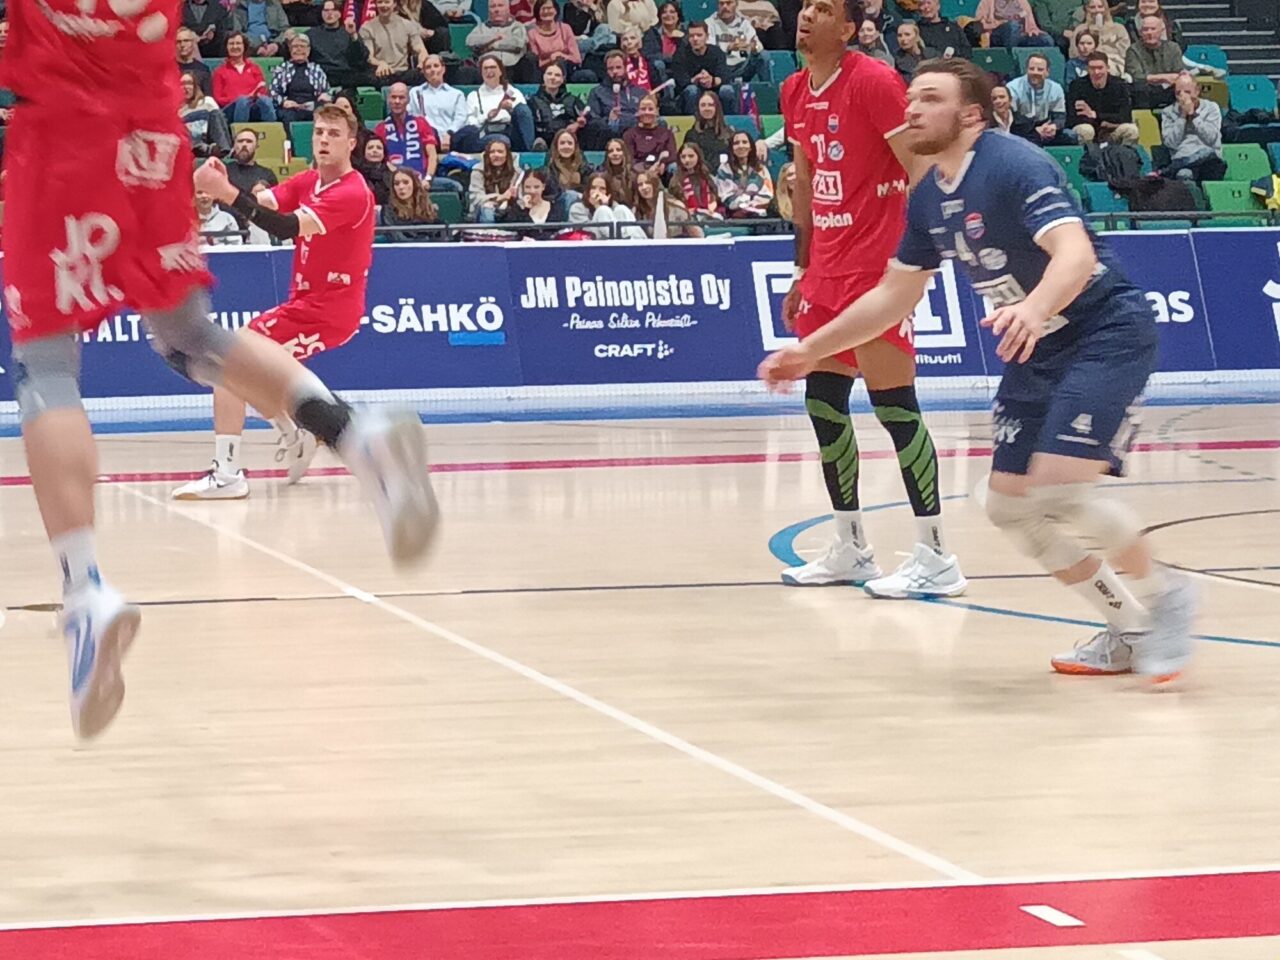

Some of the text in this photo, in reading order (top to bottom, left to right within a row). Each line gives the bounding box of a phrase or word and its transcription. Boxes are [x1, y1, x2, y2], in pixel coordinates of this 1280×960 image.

[520, 273, 731, 312] JM Painopiste Oy
[359, 296, 505, 334] -SÄHKÖ
[593, 343, 657, 358] CRAFT
